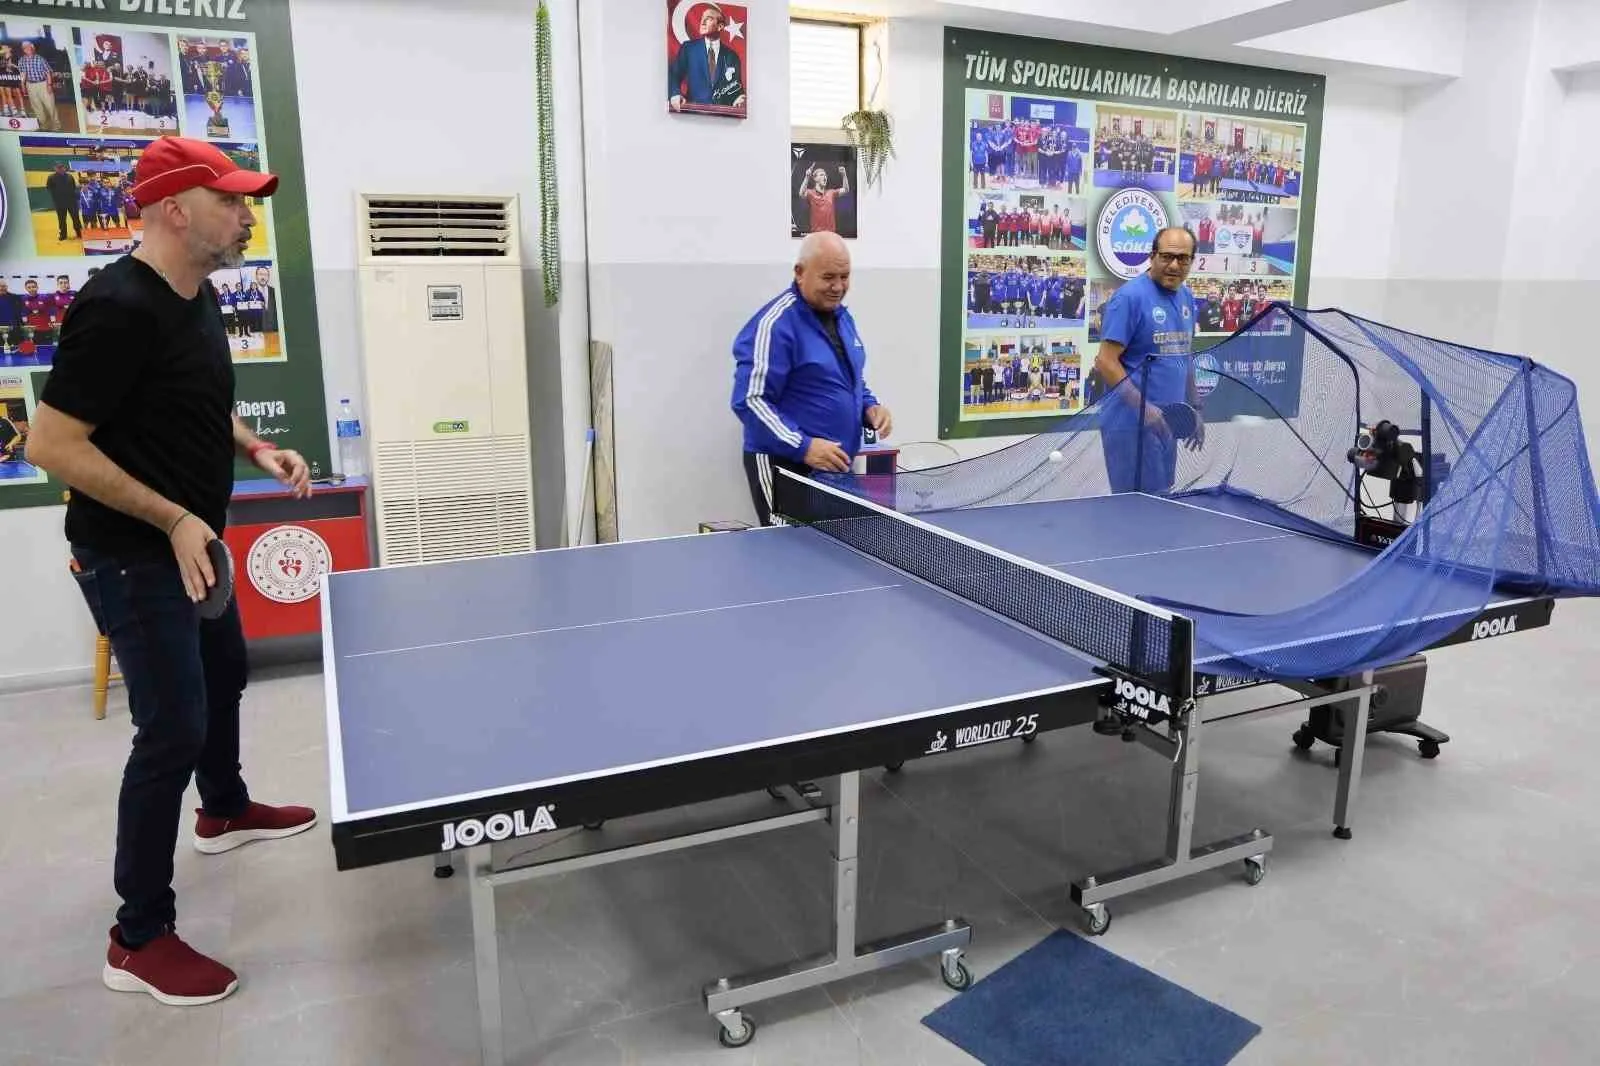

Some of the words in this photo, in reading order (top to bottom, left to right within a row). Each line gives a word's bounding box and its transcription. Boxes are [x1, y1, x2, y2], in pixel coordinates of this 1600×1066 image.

[965, 50, 1007, 83] TÜM
[1011, 59, 1161, 99] SPORCULARIMIZA
[1166, 78, 1250, 109] BAŞARILAR
[1254, 85, 1307, 115] DİLERİZ
[1103, 190, 1163, 234] BELEDİYESPO
[1199, 257, 1206, 271] 2
[1223, 256, 1229, 271] 1
[1250, 261, 1257, 272] 3
[241, 339, 248, 349] 3
[1471, 615, 1516, 640] JOOLA
[1114, 677, 1171, 715] JOOLA
[956, 724, 990, 745] WORLD
[992, 719, 1011, 737] CUP
[1012, 713, 1039, 736] 25
[441, 805, 557, 851] JOOLA
